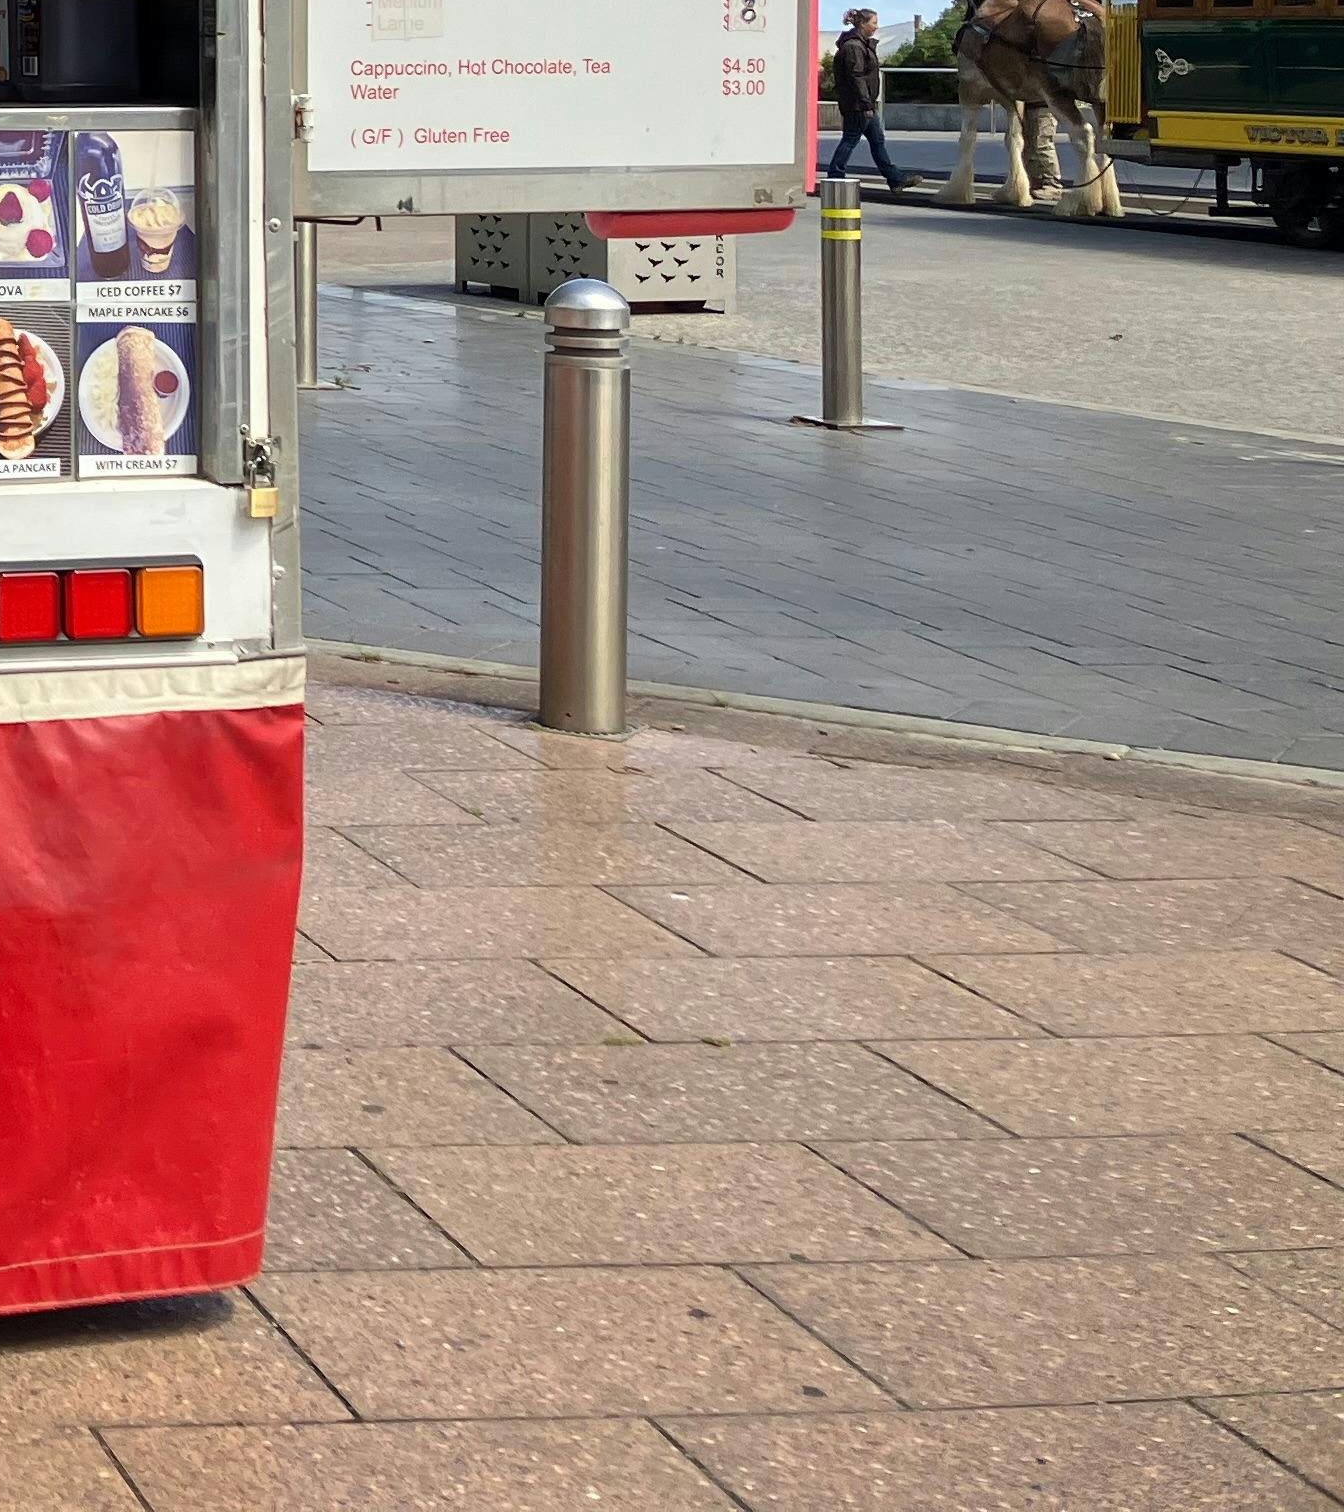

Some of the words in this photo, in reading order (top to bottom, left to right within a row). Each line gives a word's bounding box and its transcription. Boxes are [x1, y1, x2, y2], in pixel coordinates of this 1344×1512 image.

[351, 84, 400, 101] Water
[721, 78, 767, 97] $3.00
[96, 287, 122, 298] ICED
[124, 285, 165, 296] COFFEE
[168, 284, 182, 296] $7
[88, 308, 122, 317] MAPLE
[126, 307, 173, 317] PANCAKE
[176, 306, 189, 317] $6
[12, 463, 56, 472] PANCAKE
[96, 460, 123, 470] WITH
[126, 460, 162, 470] CREAM
[165, 458, 178, 470] $7
